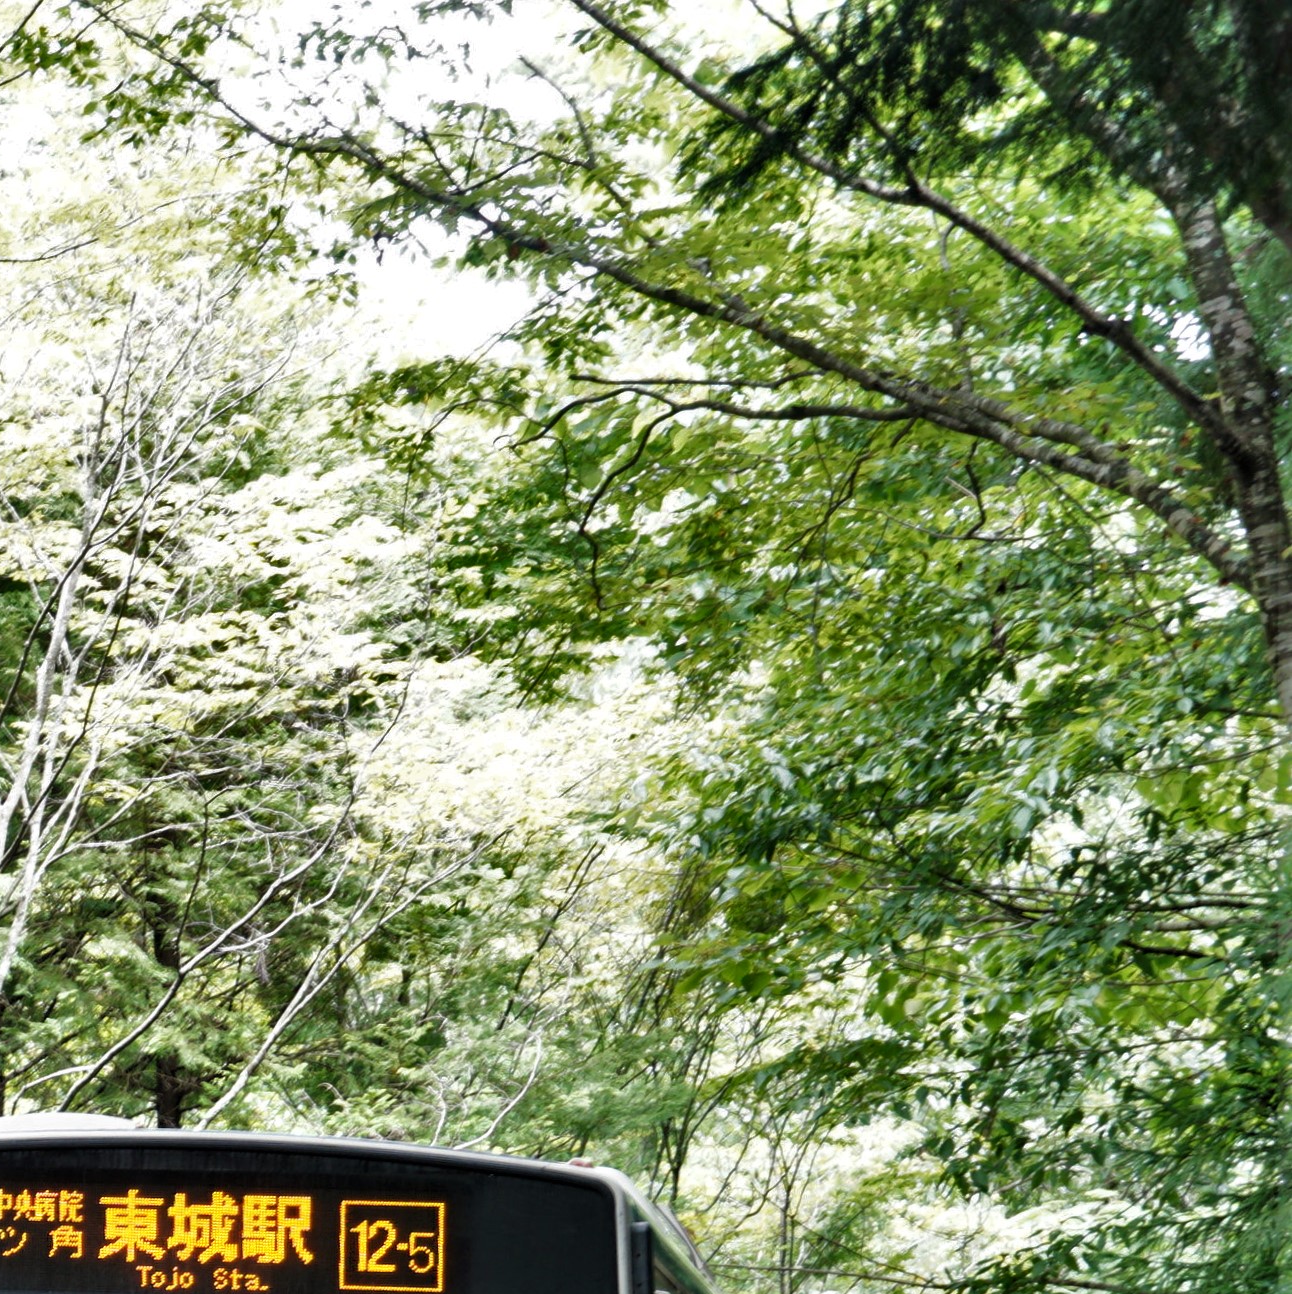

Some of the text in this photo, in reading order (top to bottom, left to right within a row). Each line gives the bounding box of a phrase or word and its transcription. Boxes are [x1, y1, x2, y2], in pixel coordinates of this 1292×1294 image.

[97, 1189, 314, 1265] 東城駅
[350, 1219, 434, 1274] 12-5
[135, 1265, 269, 1292] Tojo Sta.
